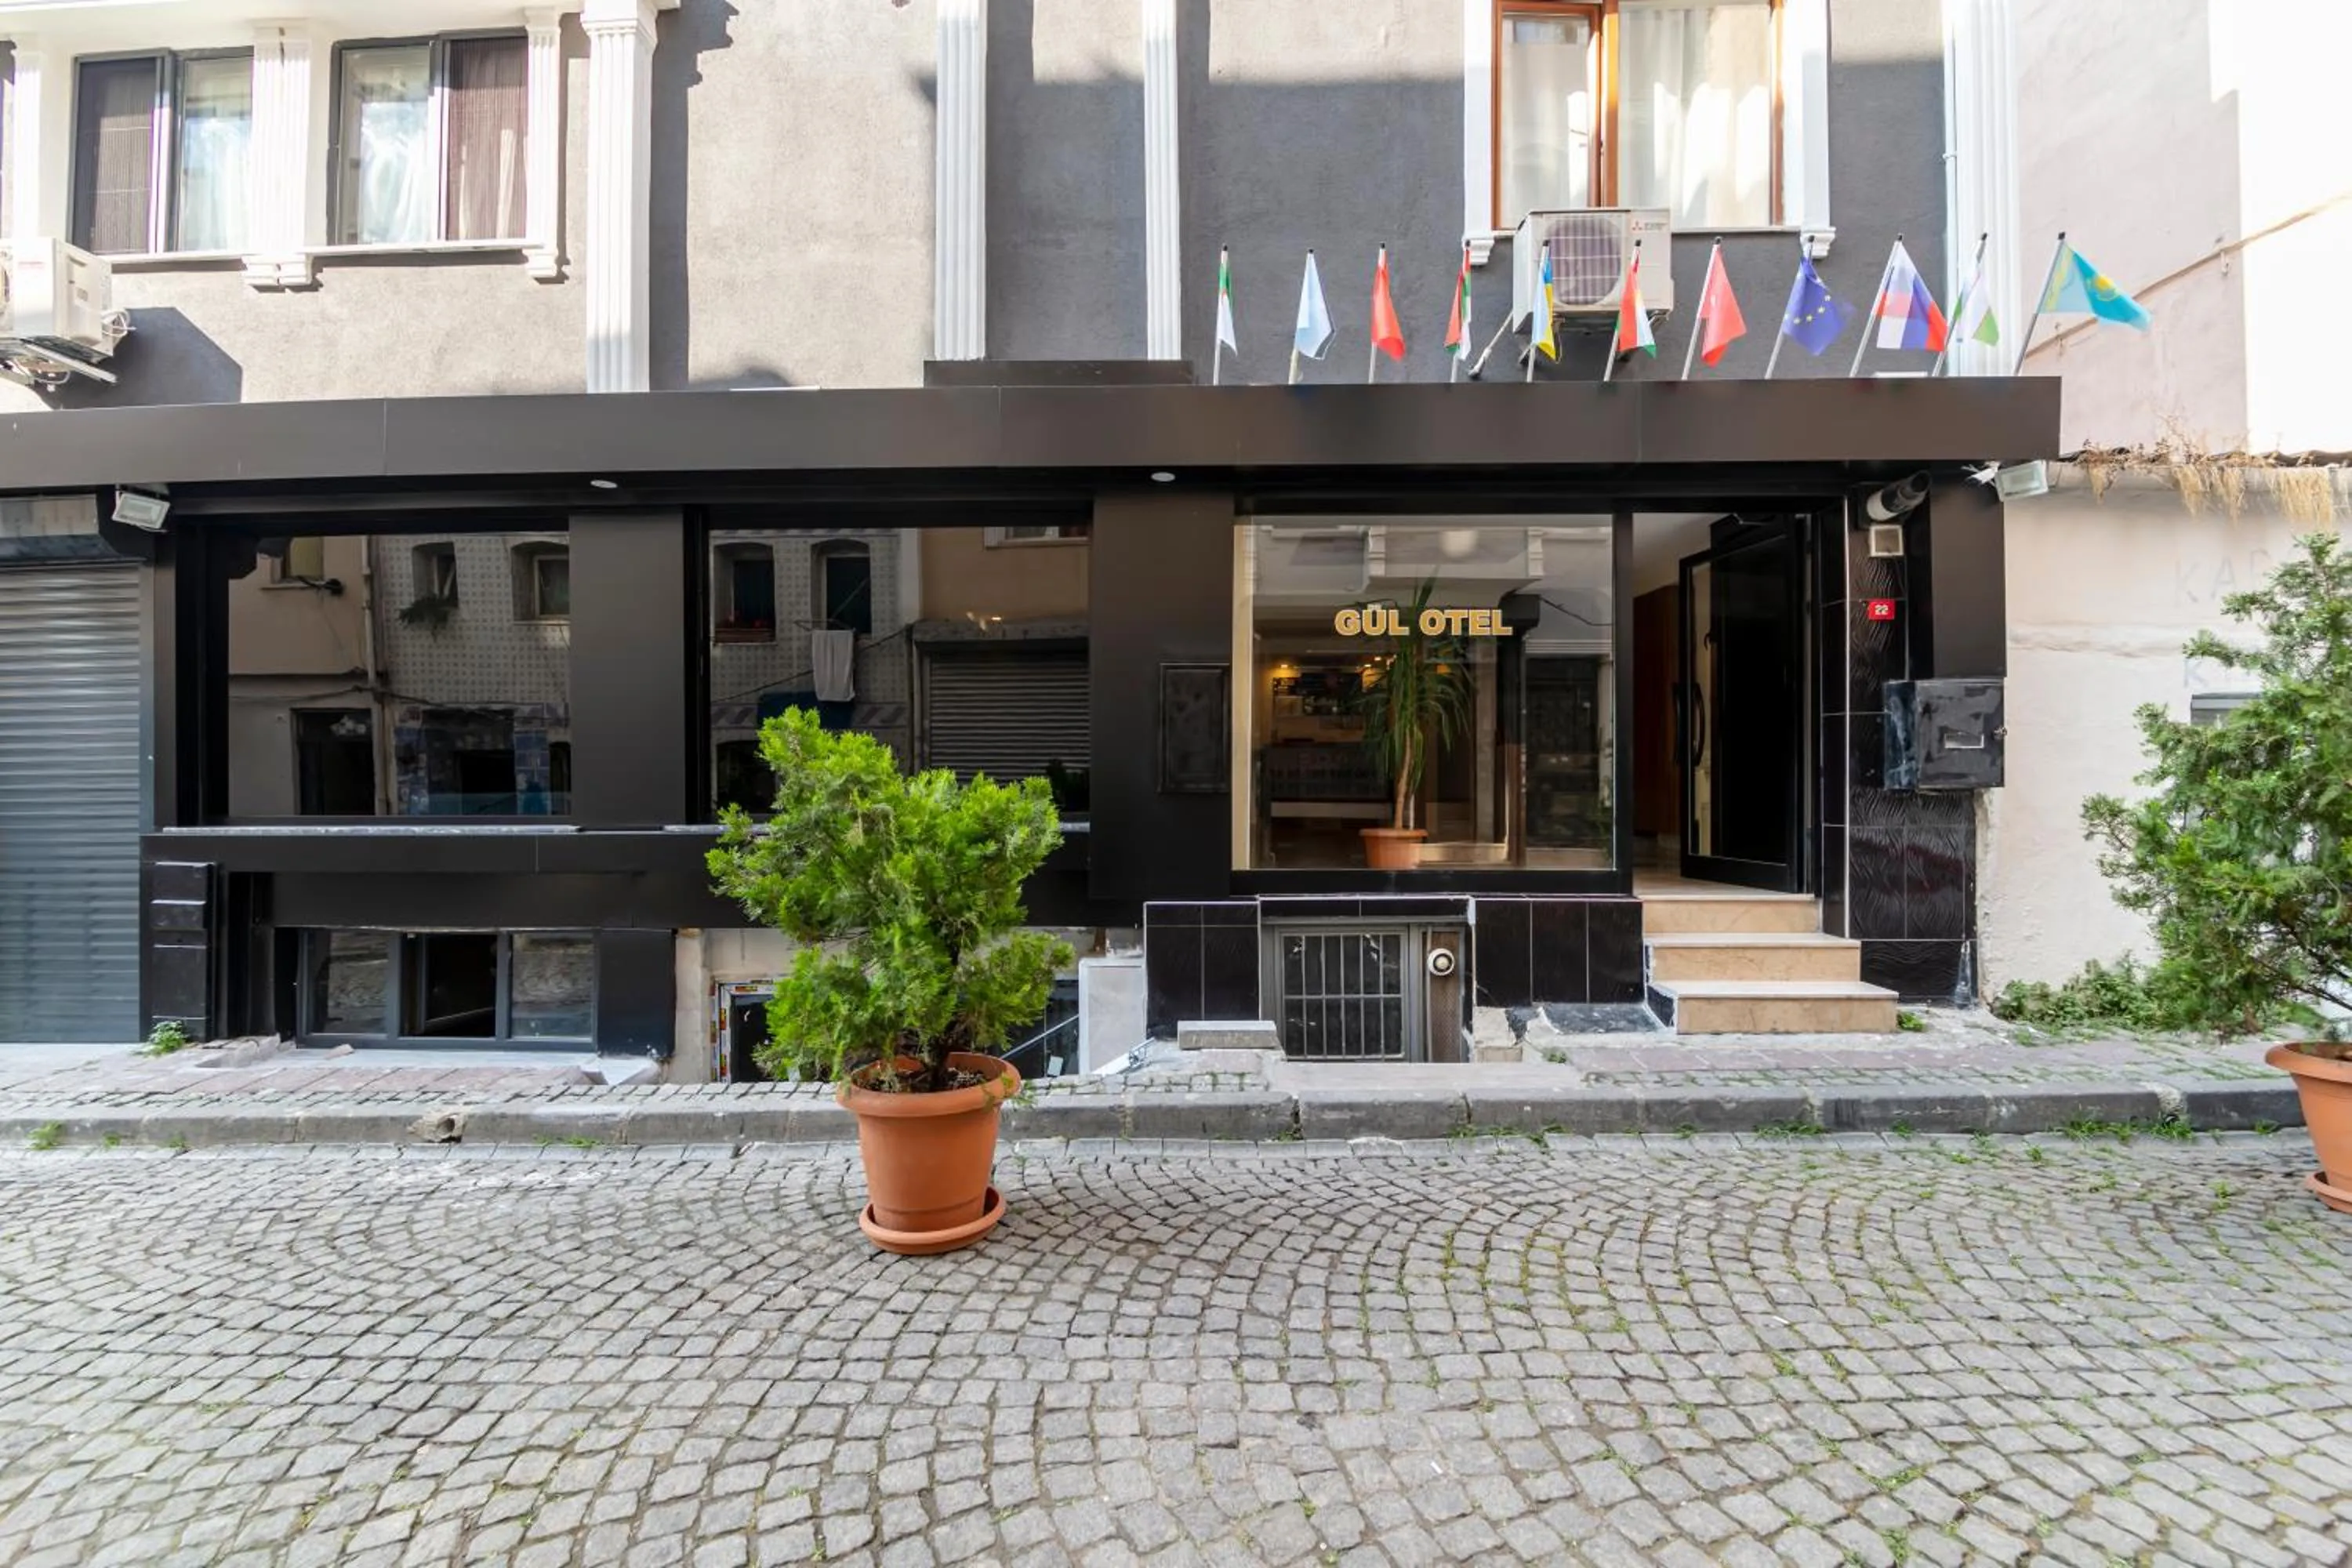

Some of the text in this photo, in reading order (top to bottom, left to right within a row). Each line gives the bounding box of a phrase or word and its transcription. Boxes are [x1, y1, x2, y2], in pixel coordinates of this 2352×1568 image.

[1334, 604, 1512, 636] GÜL OTEL
[1875, 604, 1888, 615] 22
